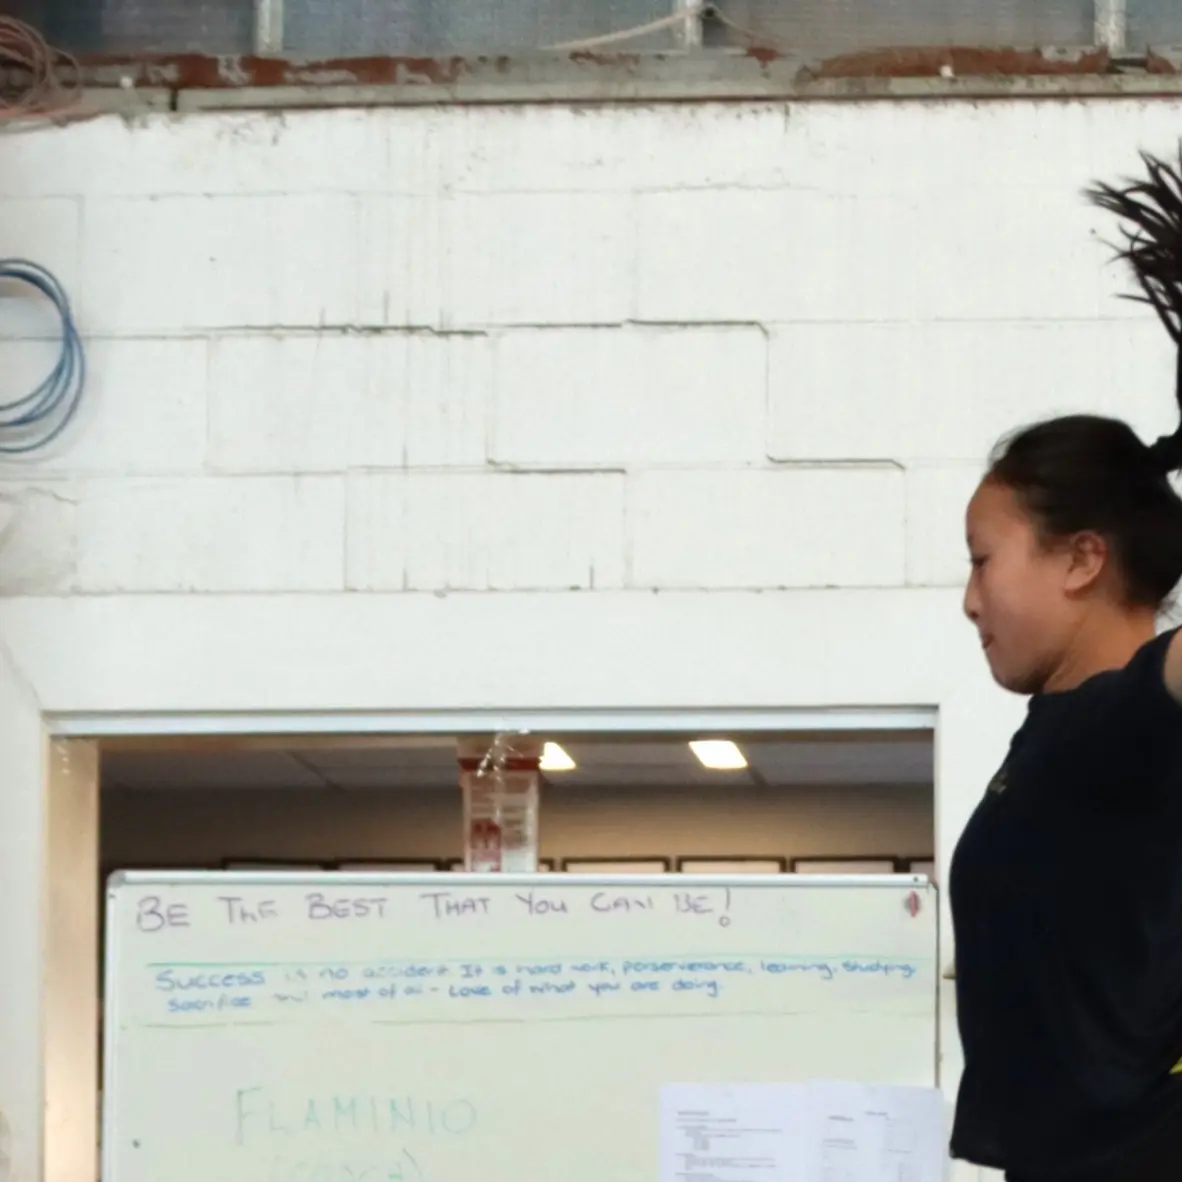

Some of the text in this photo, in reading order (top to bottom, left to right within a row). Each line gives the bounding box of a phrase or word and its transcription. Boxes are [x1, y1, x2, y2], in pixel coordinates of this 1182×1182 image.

[136, 895, 190, 932] BE
[304, 892, 388, 920] BEST
[421, 893, 491, 918] THAT
[319, 968, 349, 980] no
[234, 1085, 478, 1147] FLAMINIO
